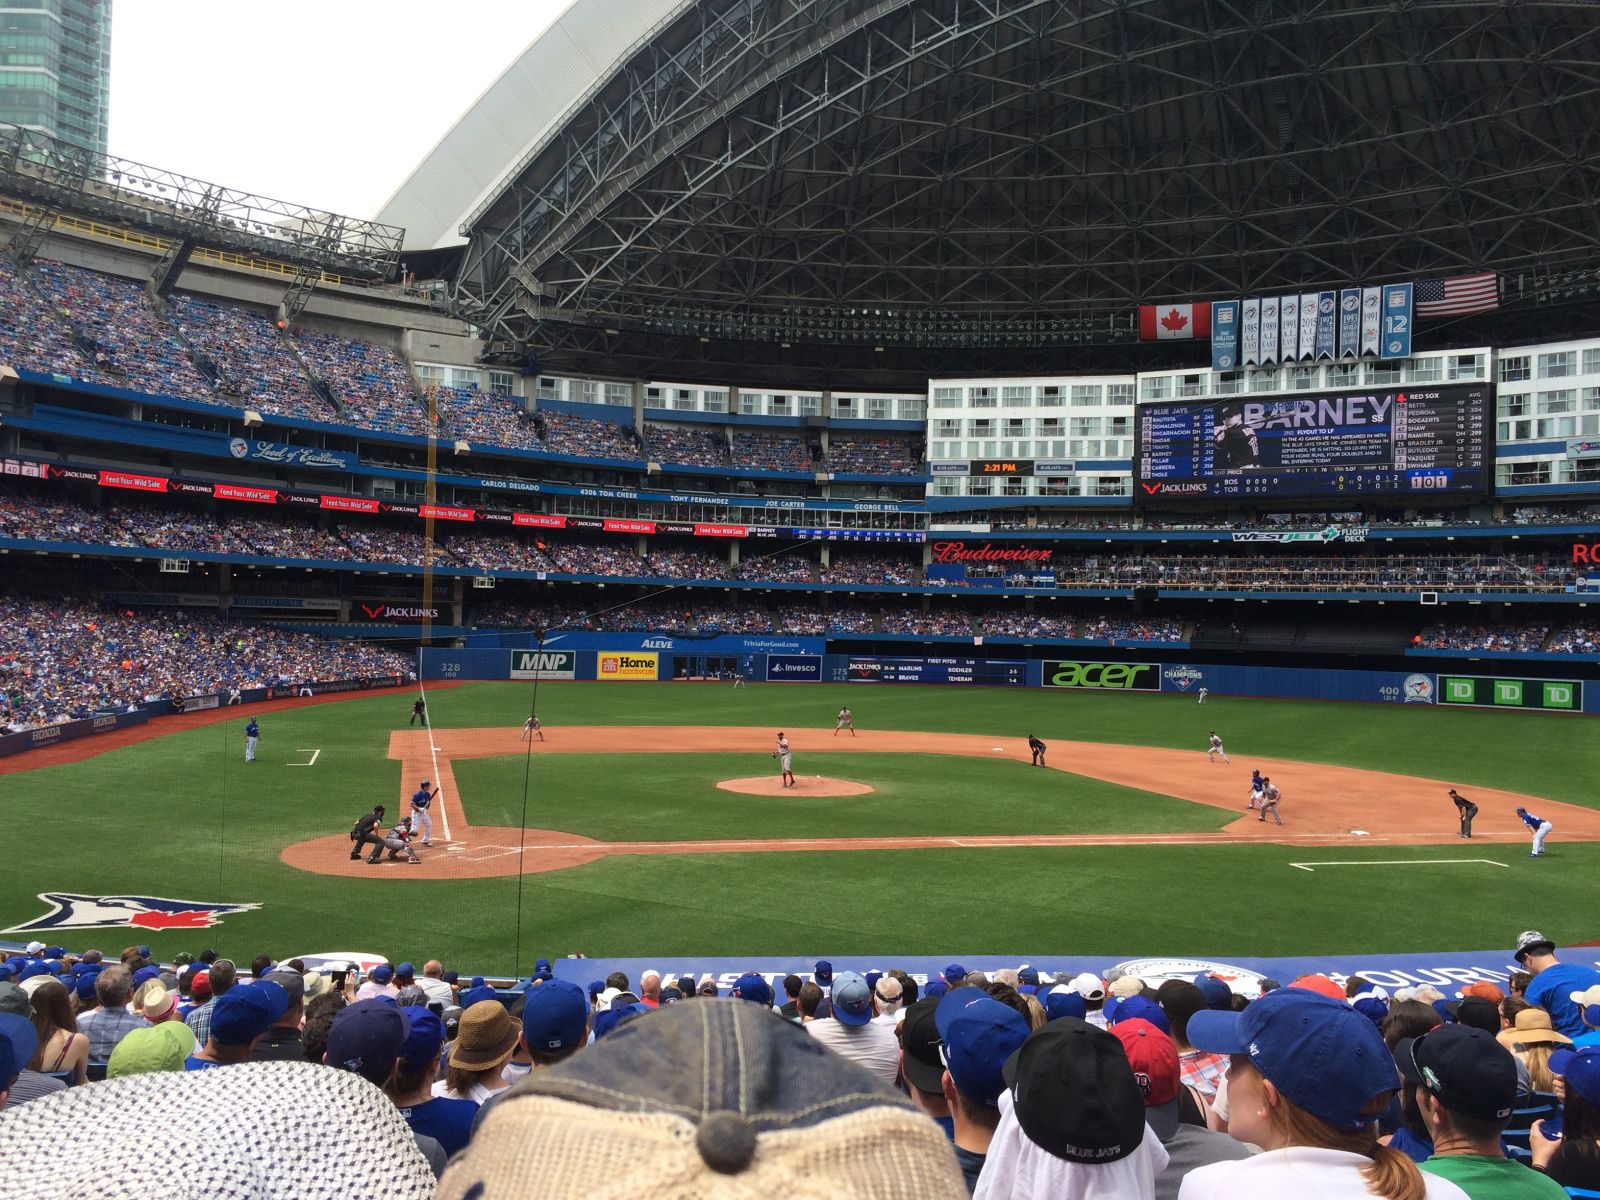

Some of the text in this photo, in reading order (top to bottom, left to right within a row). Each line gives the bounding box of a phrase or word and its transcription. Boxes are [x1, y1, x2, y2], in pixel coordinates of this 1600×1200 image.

[1283, 320, 1296, 329] 1991
[1344, 314, 1357, 322] 1993
[1386, 316, 1407, 333] 12
[1244, 395, 1391, 429] BARNEY
[252, 441, 346, 468] Level of Excellence
[1233, 532, 1321, 543] WESTJET
[934, 542, 1052, 561] Budweiser
[384, 607, 410, 617] JACK
[641, 639, 674, 648] ALEVE
[441, 663, 460, 671] 328
[520, 654, 567, 669] MNP
[620, 657, 655, 668] Home
[1052, 663, 1150, 688] acer
[1449, 683, 1472, 697] TD
[1497, 685, 1520, 700] TD
[1547, 687, 1570, 702] TD
[93, 716, 116, 727] HONDA
[32, 727, 60, 741] HONDA
[1066, 1144, 1120, 1158] BLUE JAYS
